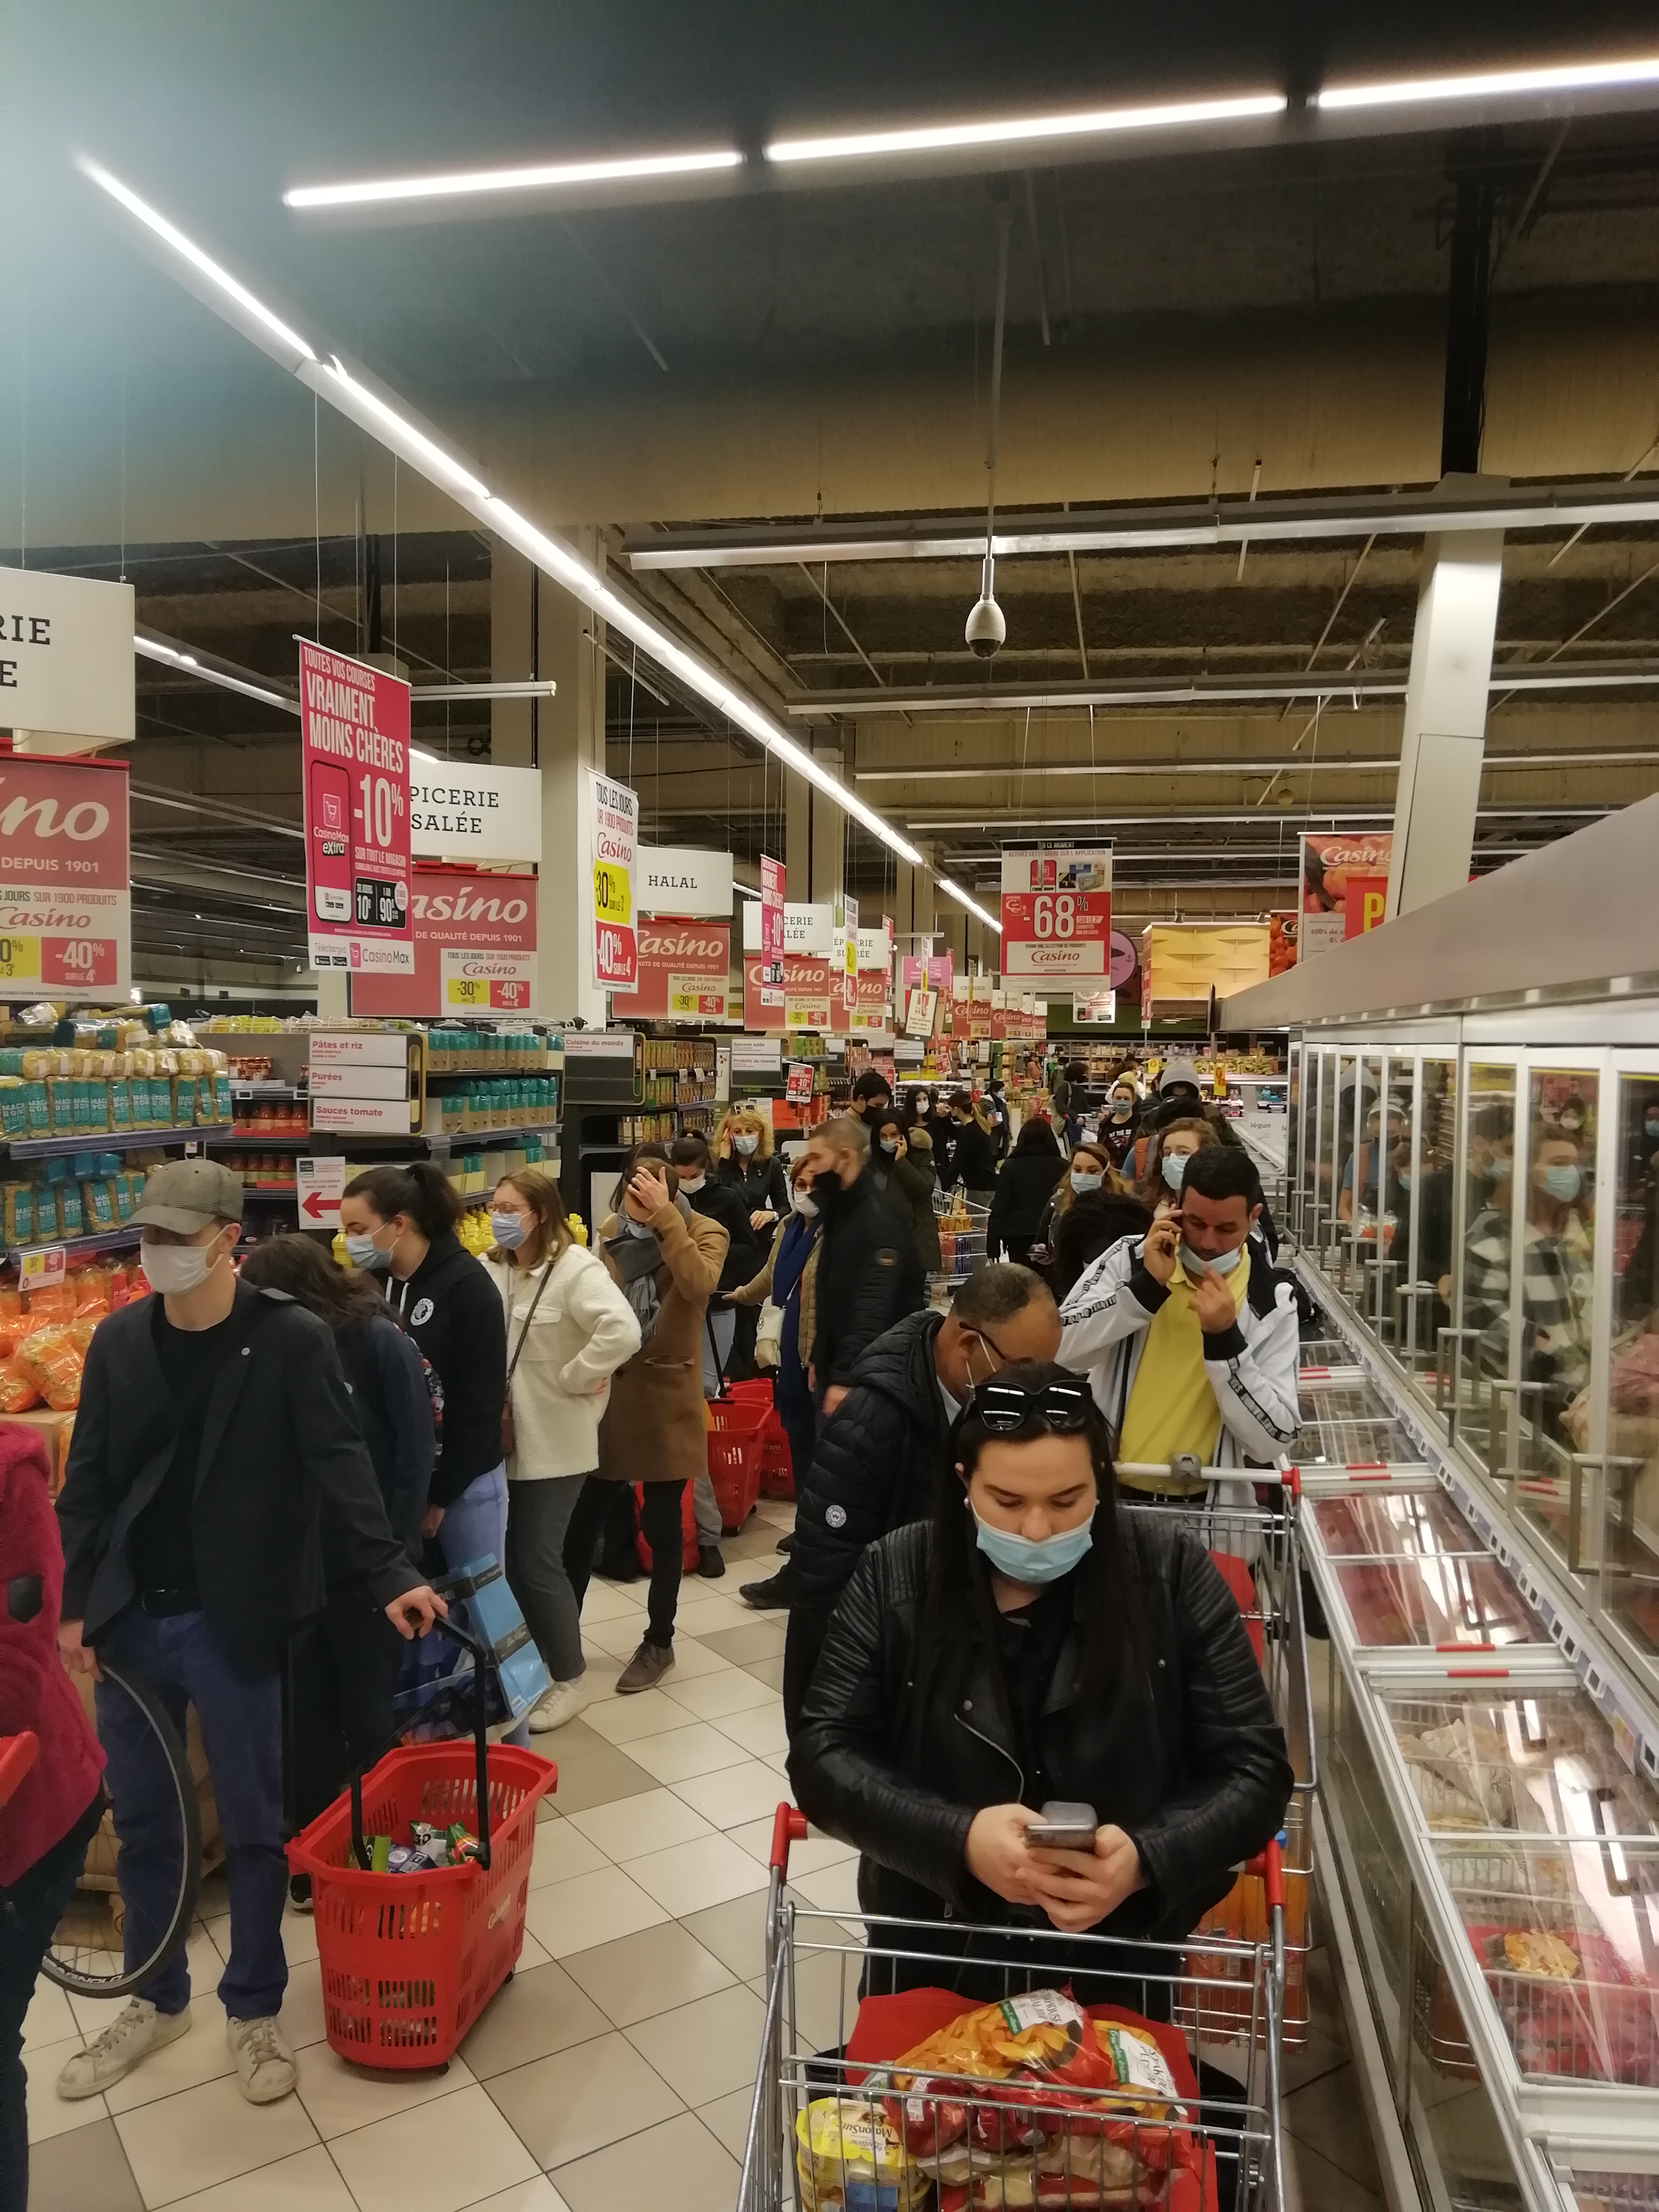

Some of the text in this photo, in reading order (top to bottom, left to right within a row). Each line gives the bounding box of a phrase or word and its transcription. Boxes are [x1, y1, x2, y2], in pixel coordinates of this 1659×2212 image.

[303, 646, 375, 692] TOUTES VOS COURSES
[306, 670, 375, 728] VRAIMENT
[309, 710, 404, 774] MOINS CHÈRES
[596, 782, 633, 816] TOUS LES JOURS
[354, 774, 404, 847] -10%
[411, 811, 482, 833] SALÉE
[314, 826, 349, 843] CasinoMax
[322, 841, 345, 856] eXtra
[597, 832, 632, 862] Casino
[355, 846, 366, 860] SUR
[366, 848, 378, 862] TOUT
[379, 851, 385, 864] LE
[2, 857, 99, 873] DEPUIS 1901
[648, 875, 698, 889] HALAL
[4, 891, 116, 906] JOURS SUR 1900 PRODUITS
[415, 931, 428, 939] DE
[430, 931, 467, 940] QUALITÉ
[470, 933, 501, 942] DEPUIS
[784, 927, 805, 939] LÉE
[55, 941, 105, 968] -40%
[363, 949, 409, 963] CasinoMax
[1031, 950, 1080, 963] Casino
[64, 972, 77, 981] SUR
[78, 973, 85, 981] LE
[462, 962, 516, 976] Casino
[749, 965, 825, 985] Csino
[457, 981, 480, 996] -30%
[497, 982, 524, 999] -40%
[682, 983, 716, 993] Casino
[830, 978, 882, 996] Caino
[954, 1005, 989, 1016] Caino
[312, 1073, 342, 1081] Purées
[316, 1106, 383, 1116] Sauces tomate
